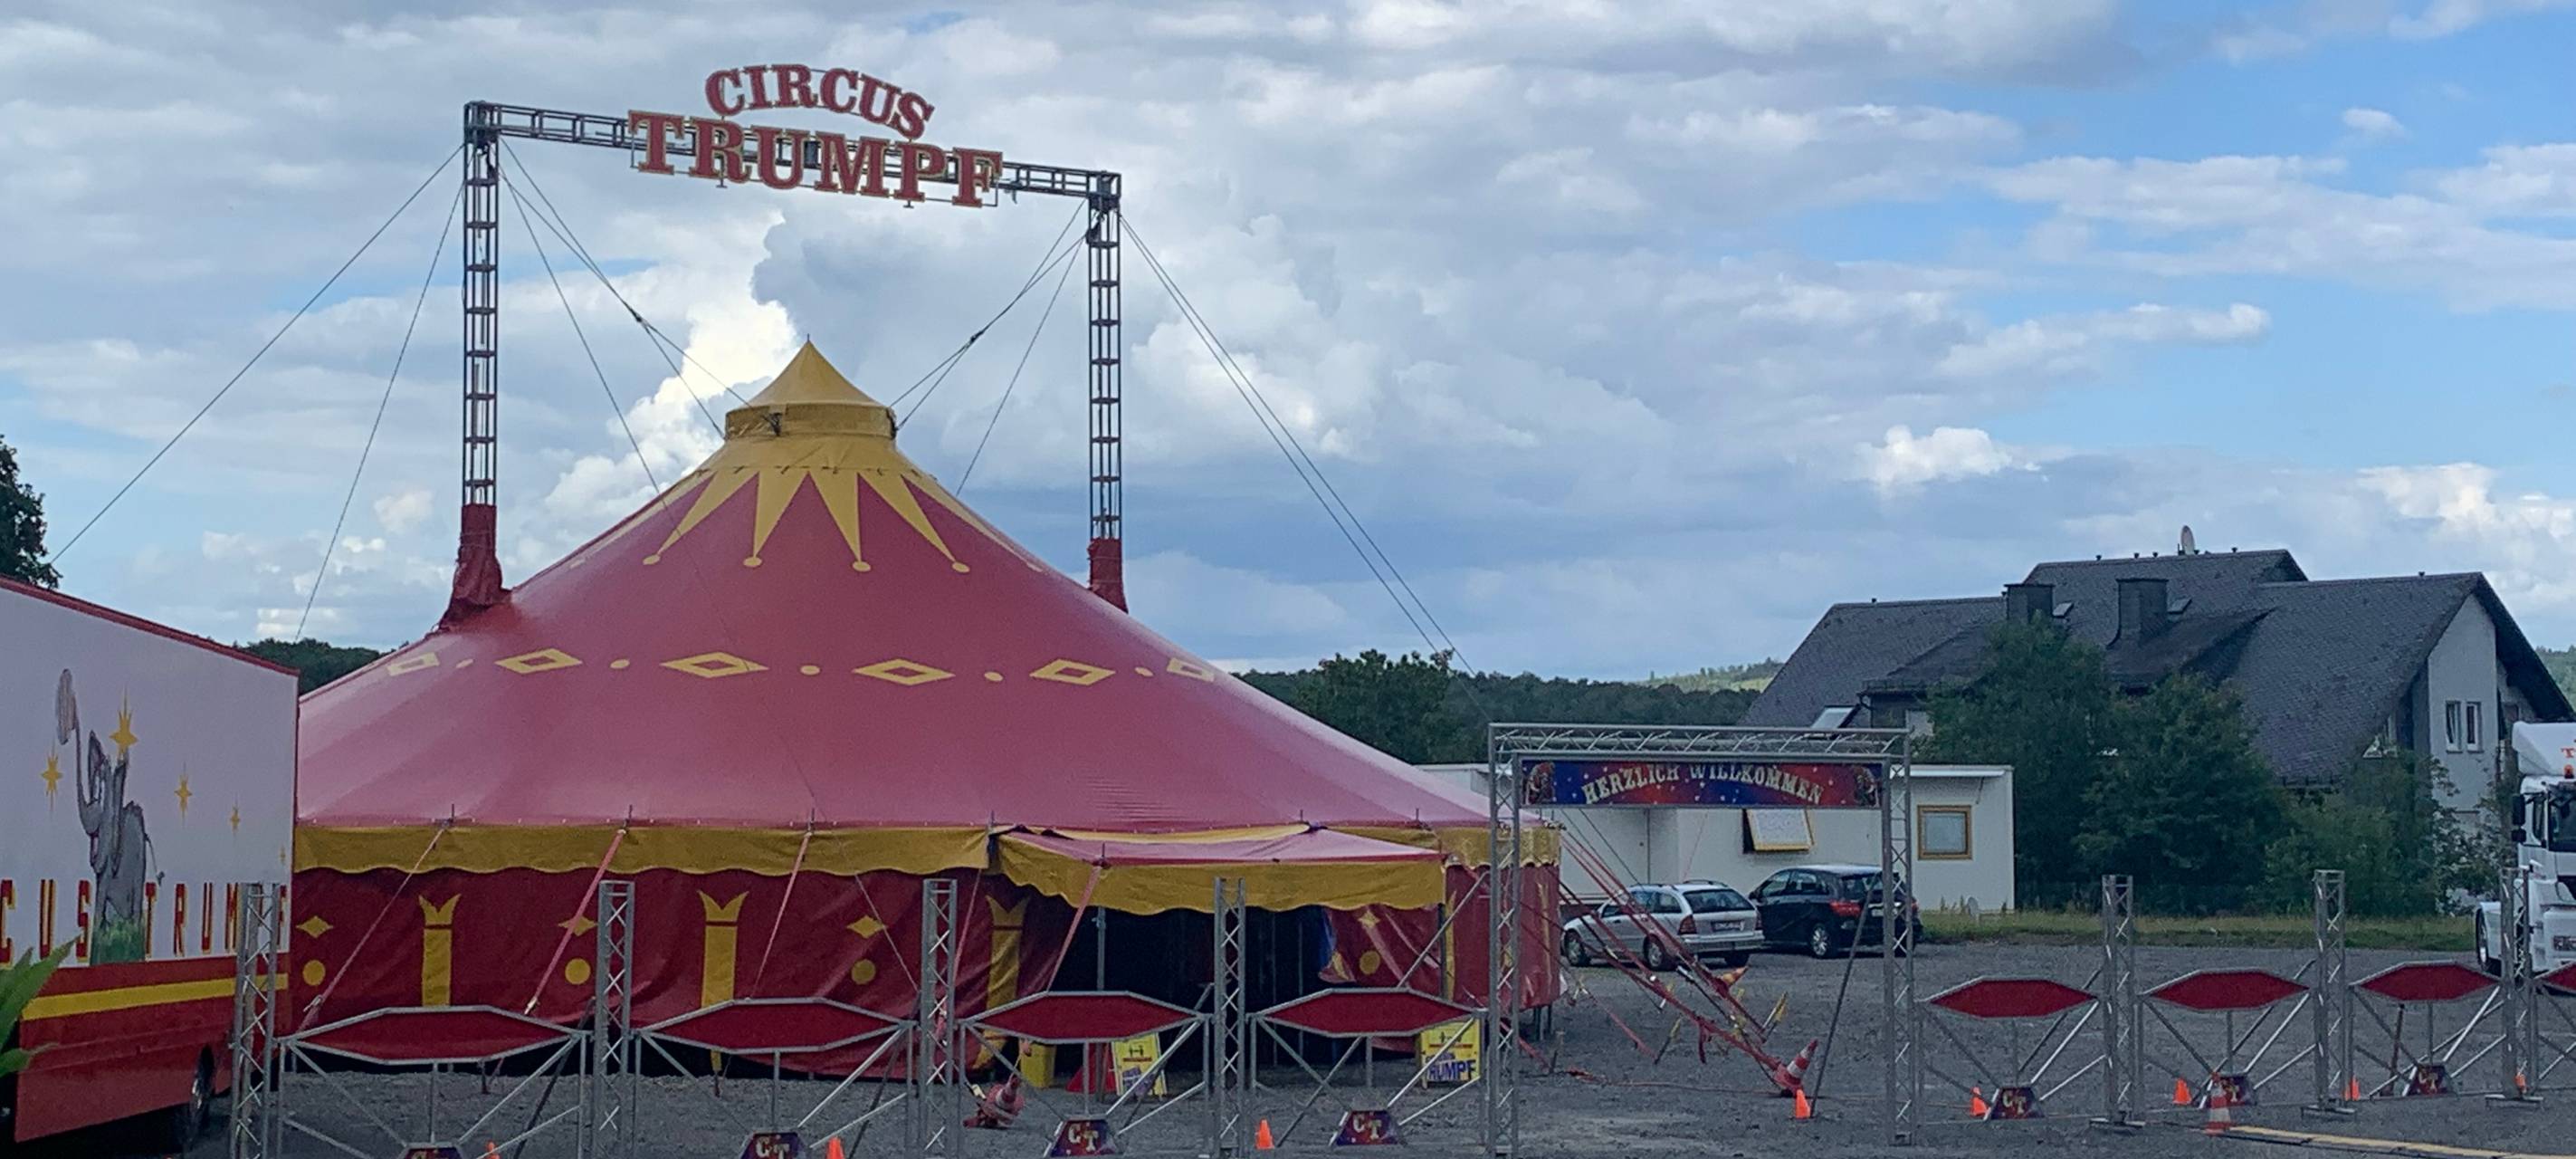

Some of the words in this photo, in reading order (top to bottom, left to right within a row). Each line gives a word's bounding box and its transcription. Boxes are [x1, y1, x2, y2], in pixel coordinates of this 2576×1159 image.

[705, 64, 934, 139] CIRCUS
[628, 110, 1003, 207] TRUMPF
[1581, 763, 1680, 804] HERZLICH
[1690, 763, 1824, 804] WILLKOMMEN
[1068, 1124, 1099, 1152] CT
[1352, 1113, 1383, 1140] CT
